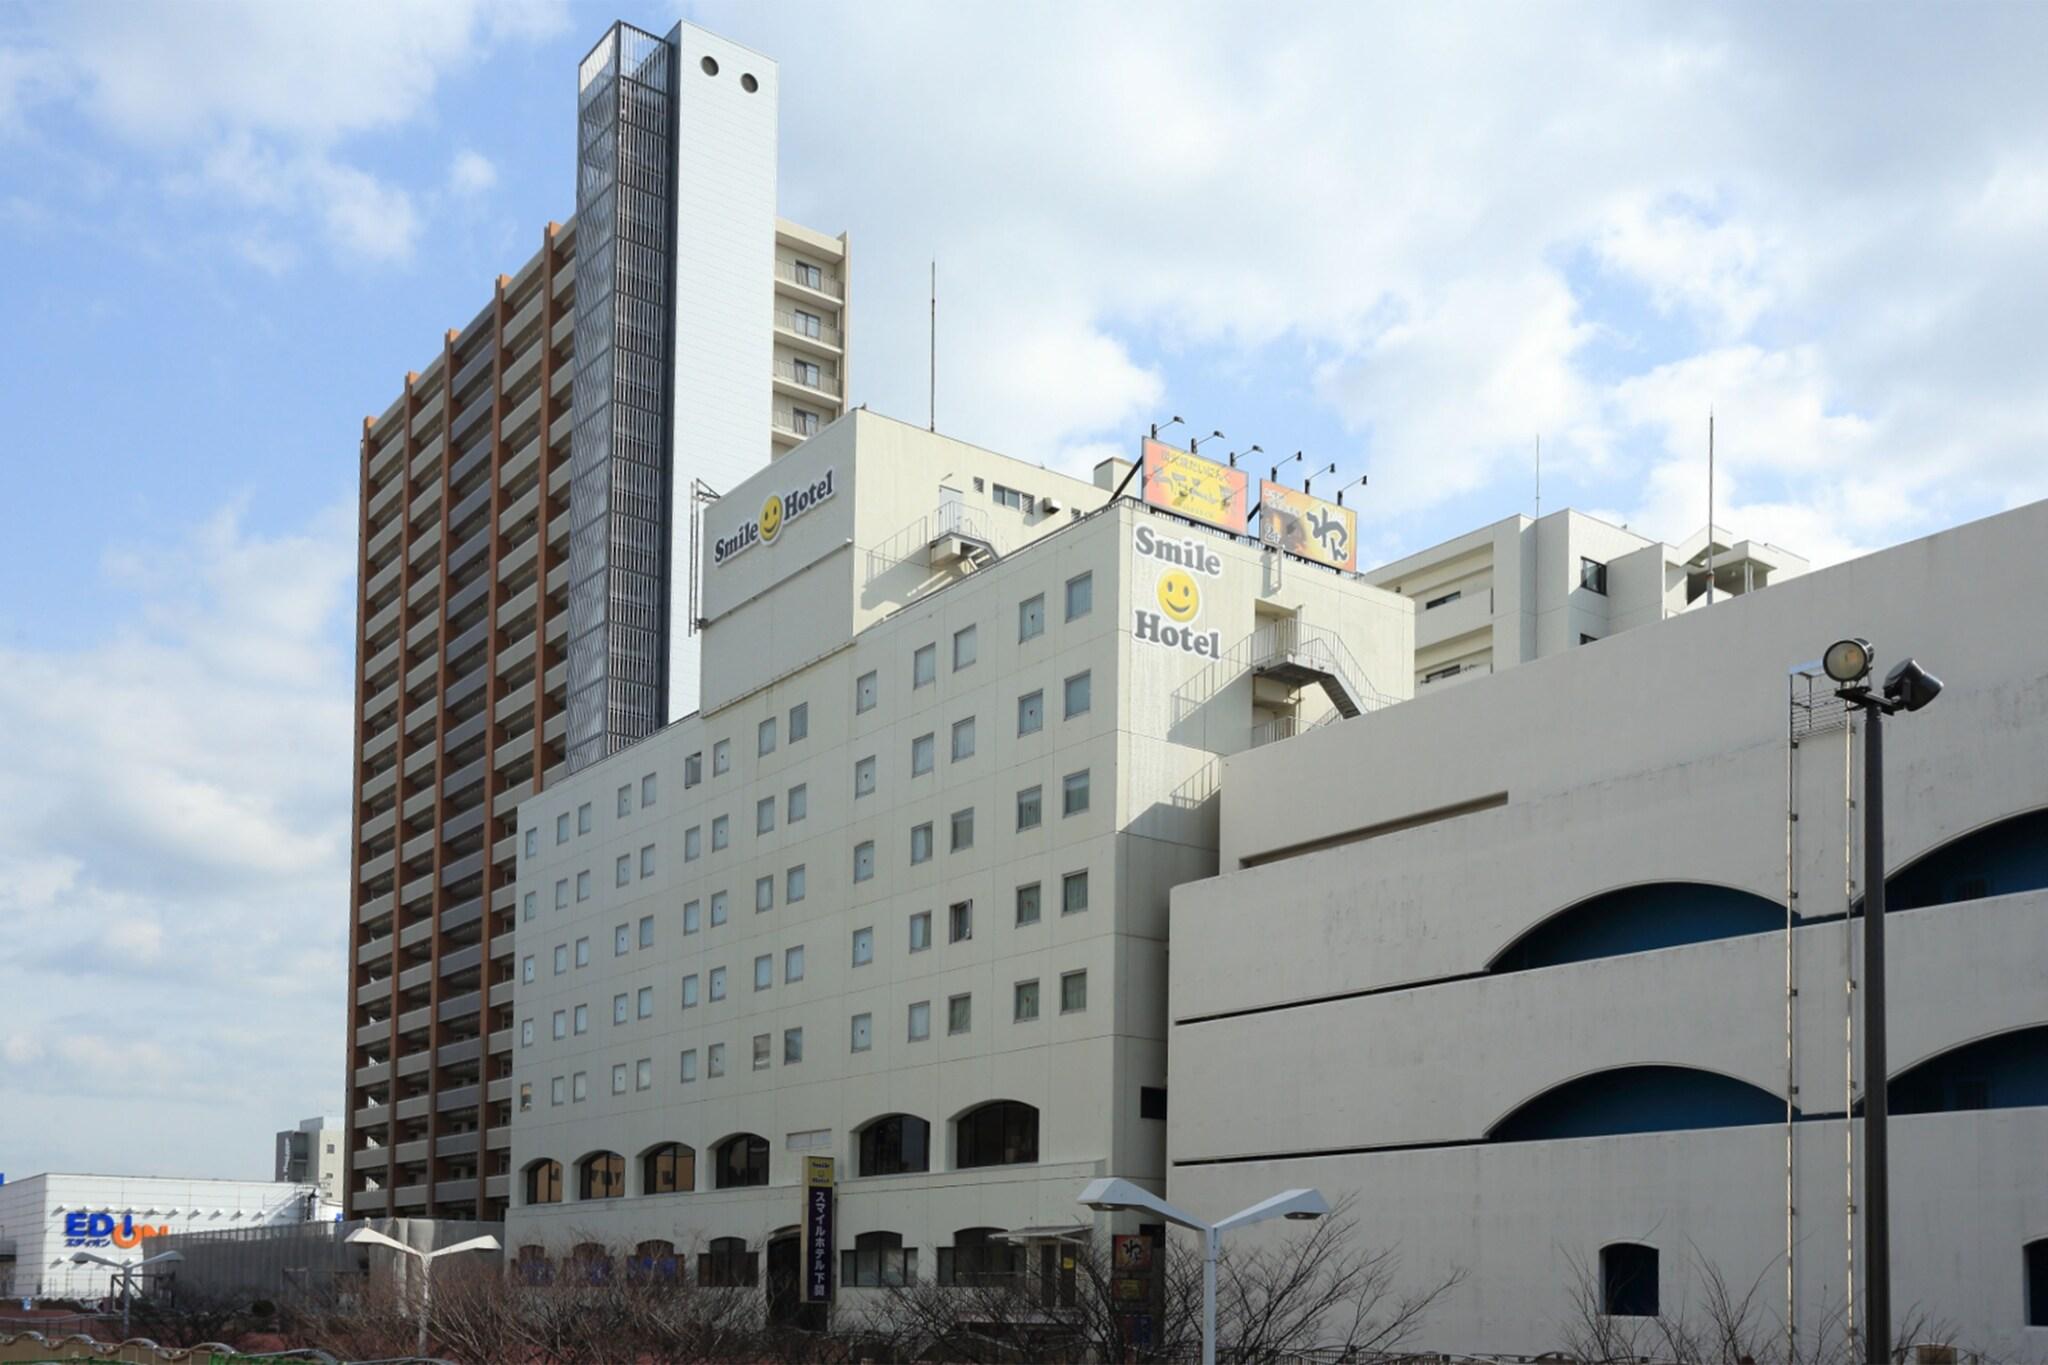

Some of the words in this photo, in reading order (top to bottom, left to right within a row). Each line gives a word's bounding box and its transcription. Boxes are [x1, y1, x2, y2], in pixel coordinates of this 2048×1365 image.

[715, 522, 758, 562] Smile
[784, 470, 833, 520] Hotel
[1135, 526, 1221, 575] Smile
[1135, 610, 1220, 660] Hotel
